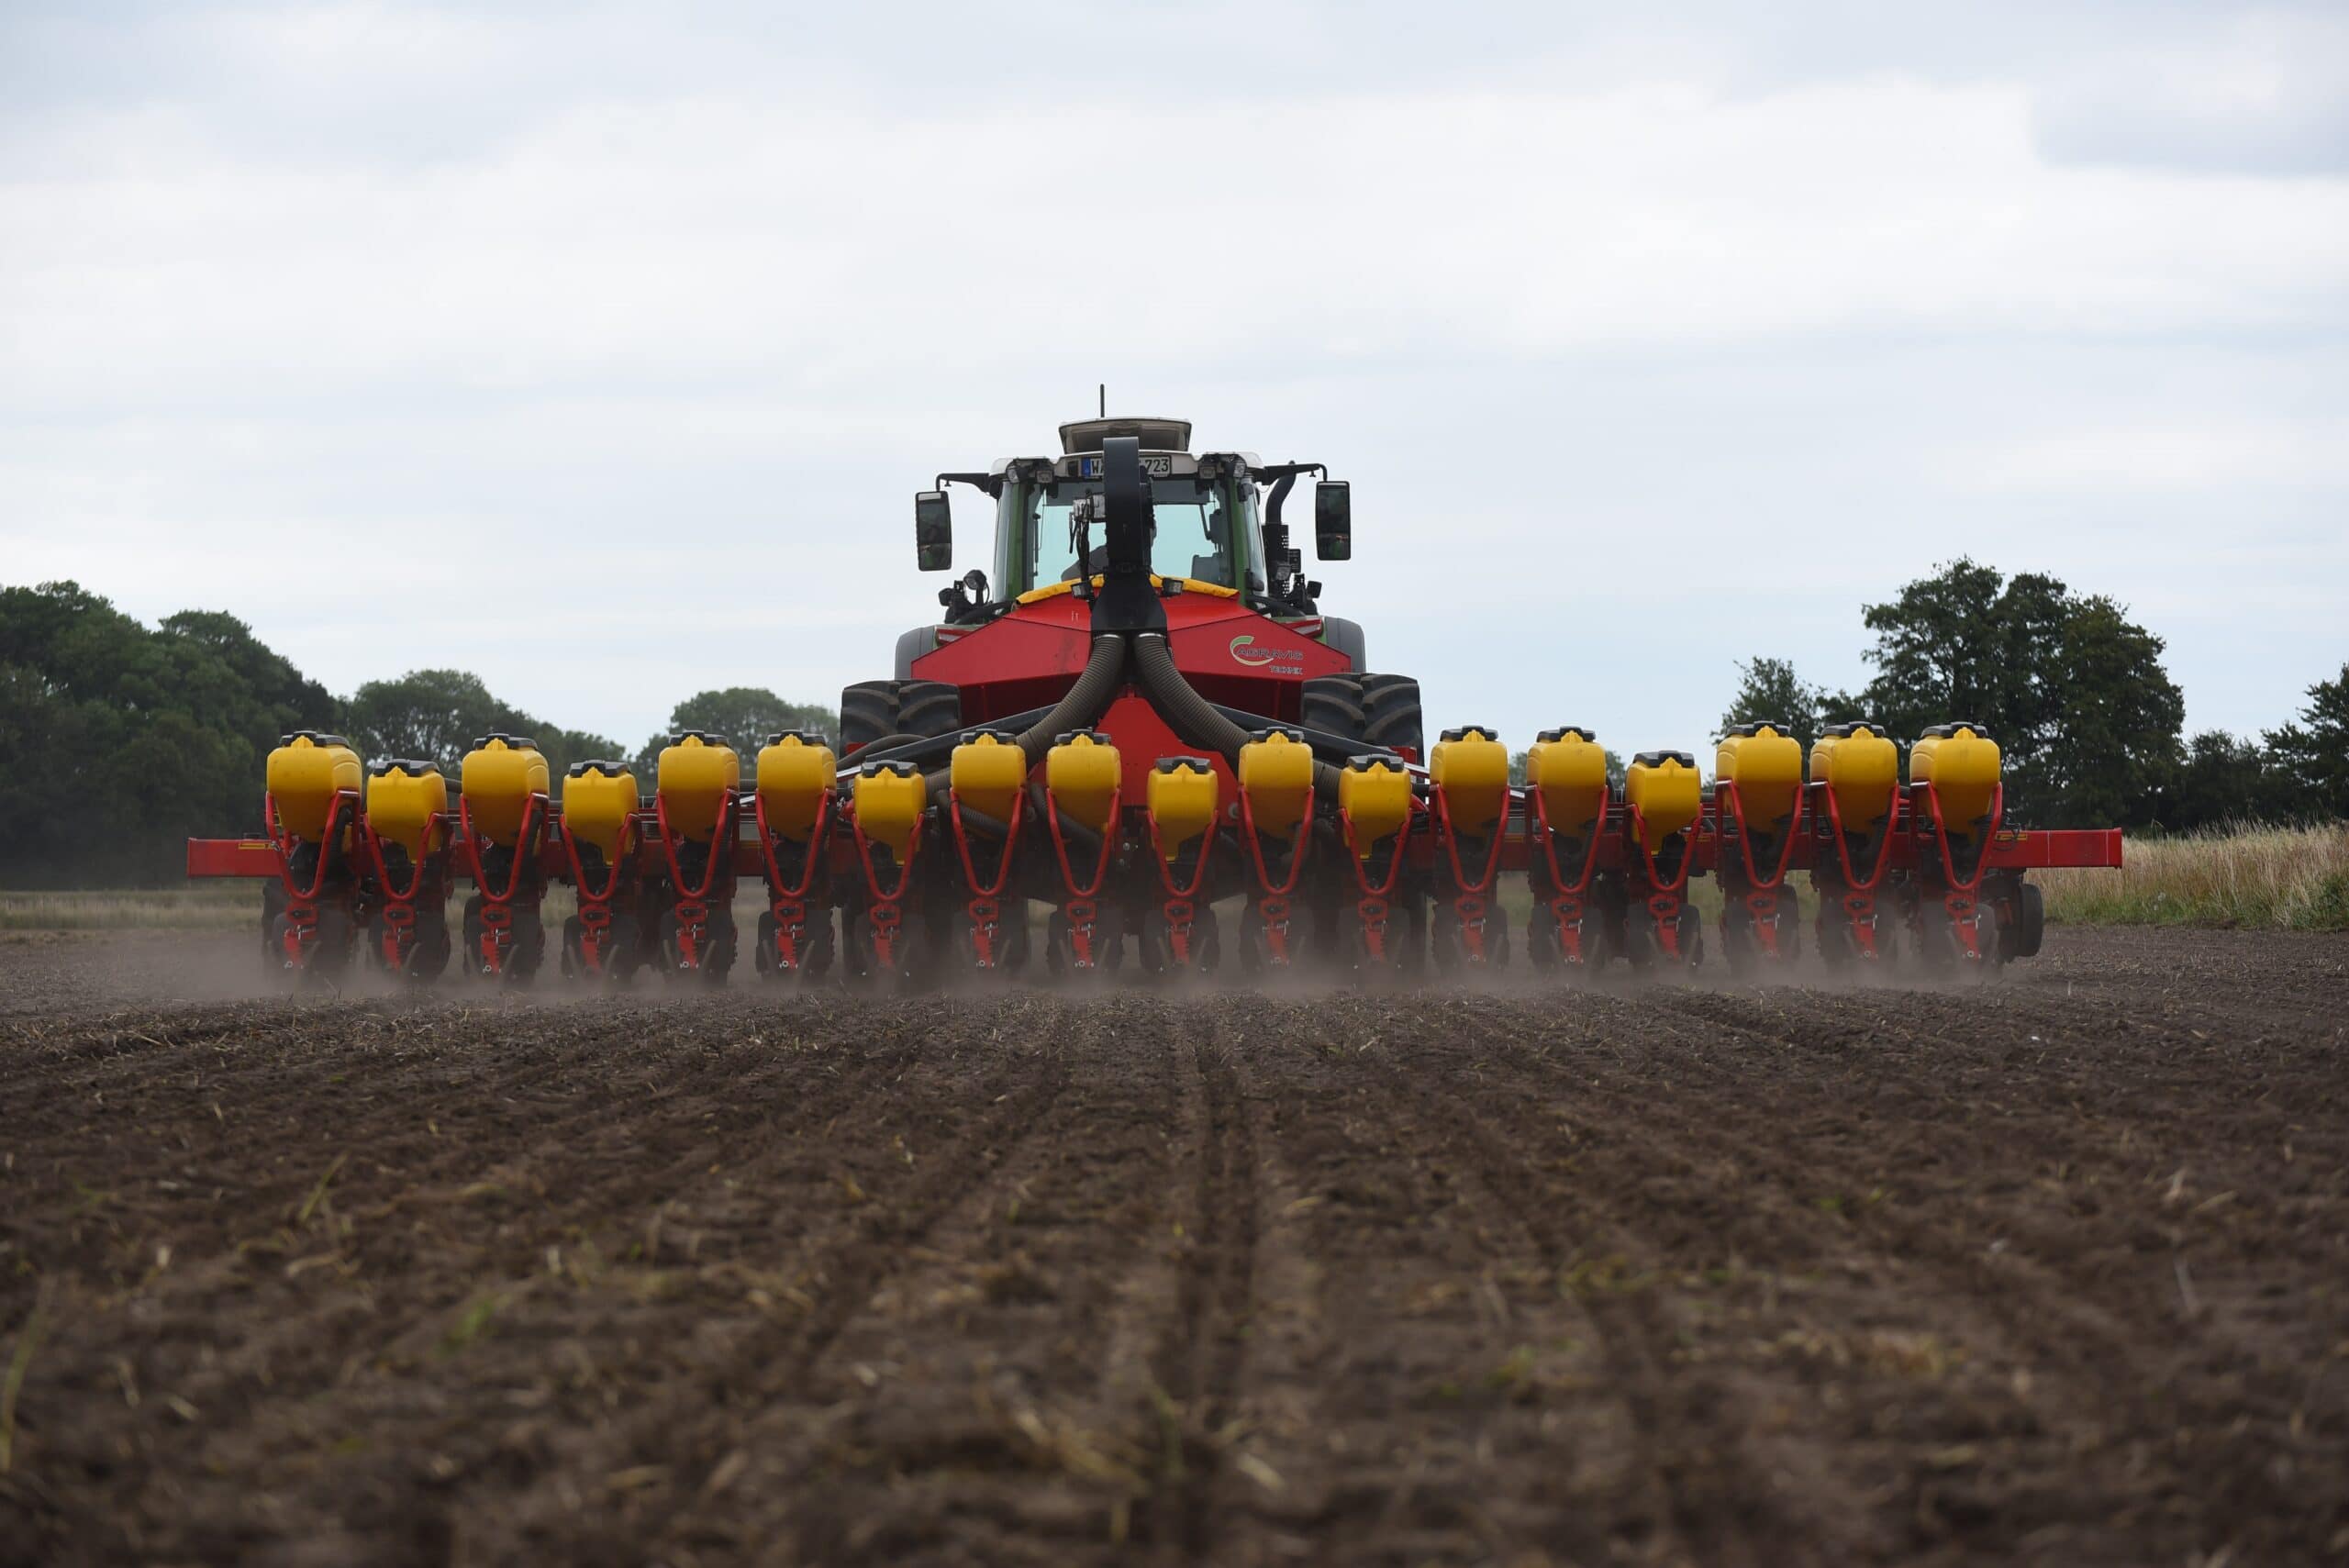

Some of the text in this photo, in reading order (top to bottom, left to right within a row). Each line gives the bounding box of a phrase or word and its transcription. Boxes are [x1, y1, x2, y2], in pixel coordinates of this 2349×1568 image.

[1145, 459, 1168, 473] 723
[1236, 647, 1303, 660] AGRAVIS
[1270, 665, 1302, 675] TECHNIK
